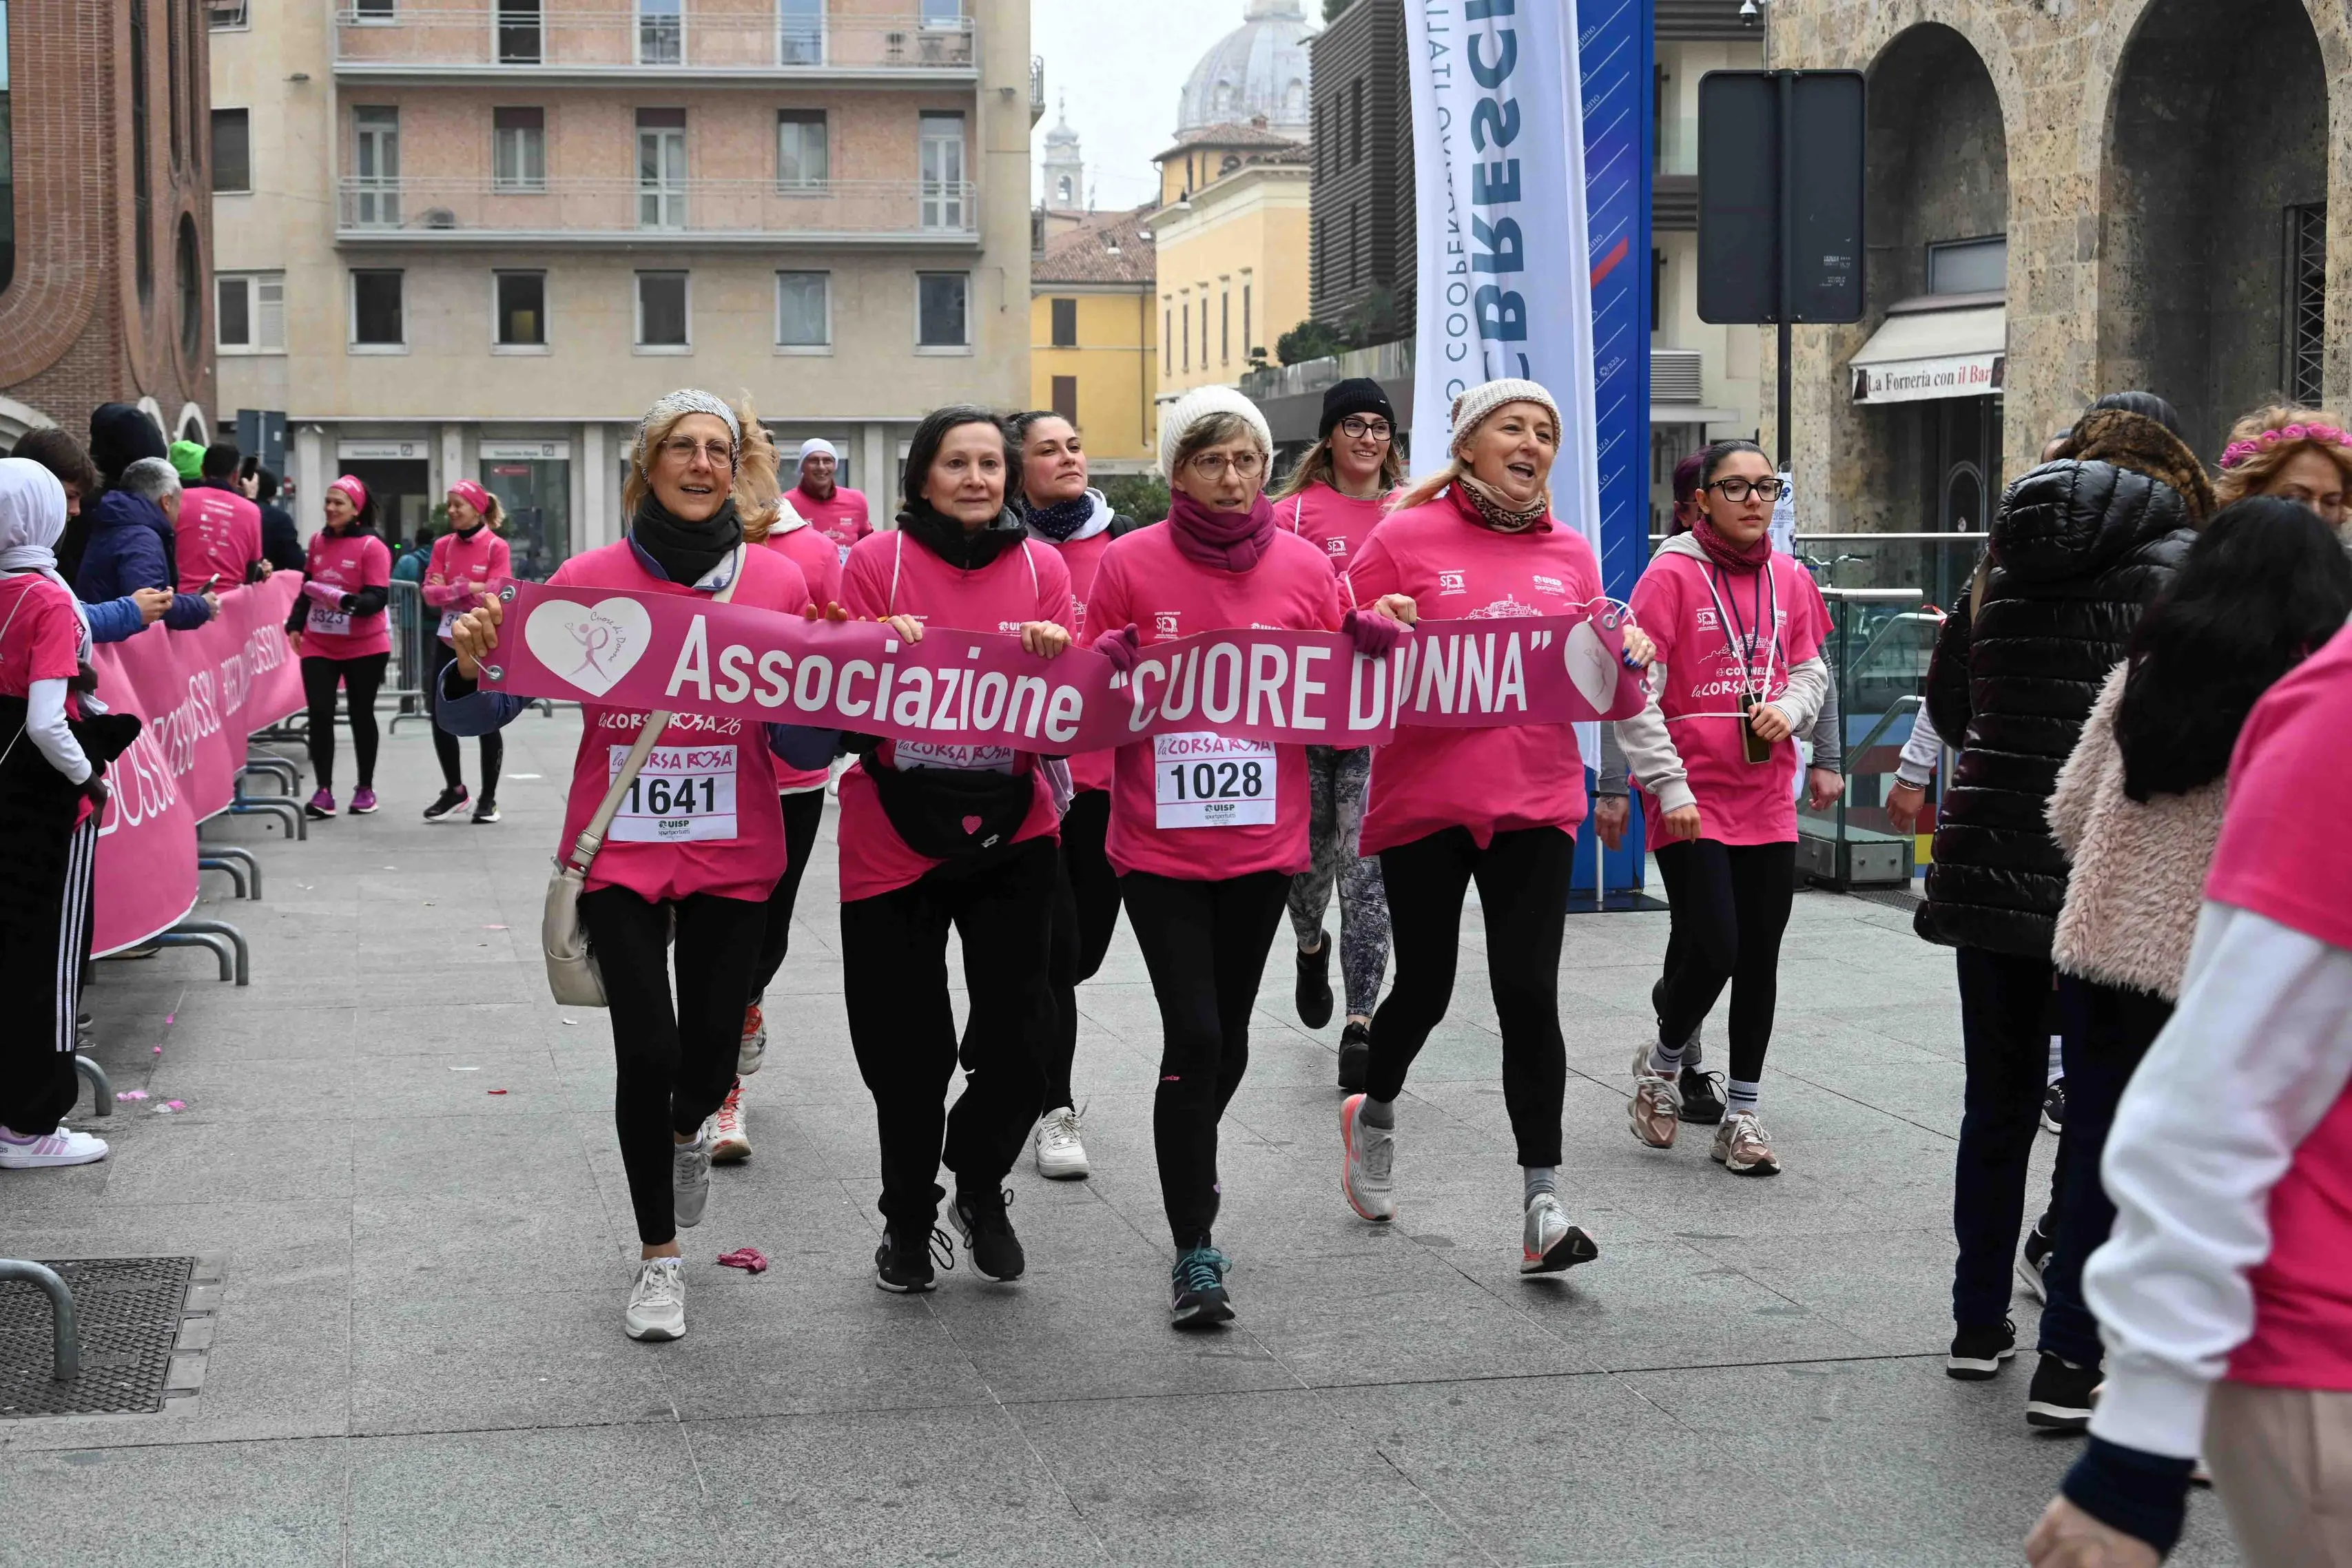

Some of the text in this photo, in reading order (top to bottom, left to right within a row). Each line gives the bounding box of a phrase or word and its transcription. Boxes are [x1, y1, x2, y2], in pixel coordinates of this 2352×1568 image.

[1868, 365, 1991, 392] La Forneria con il Bar
[590, 611, 614, 626] Cuore
[665, 615, 1083, 743] Associazione
[1400, 630, 1552, 714] NNA”
[606, 713, 651, 730] COR
[716, 717, 743, 736] 26
[1157, 739, 1167, 756] la
[1168, 737, 1224, 755] CORSA
[612, 752, 624, 767] la
[642, 752, 681, 770] RSA
[1170, 761, 1263, 801] 1028
[628, 776, 714, 815] 1641
[668, 820, 690, 828] UISP
